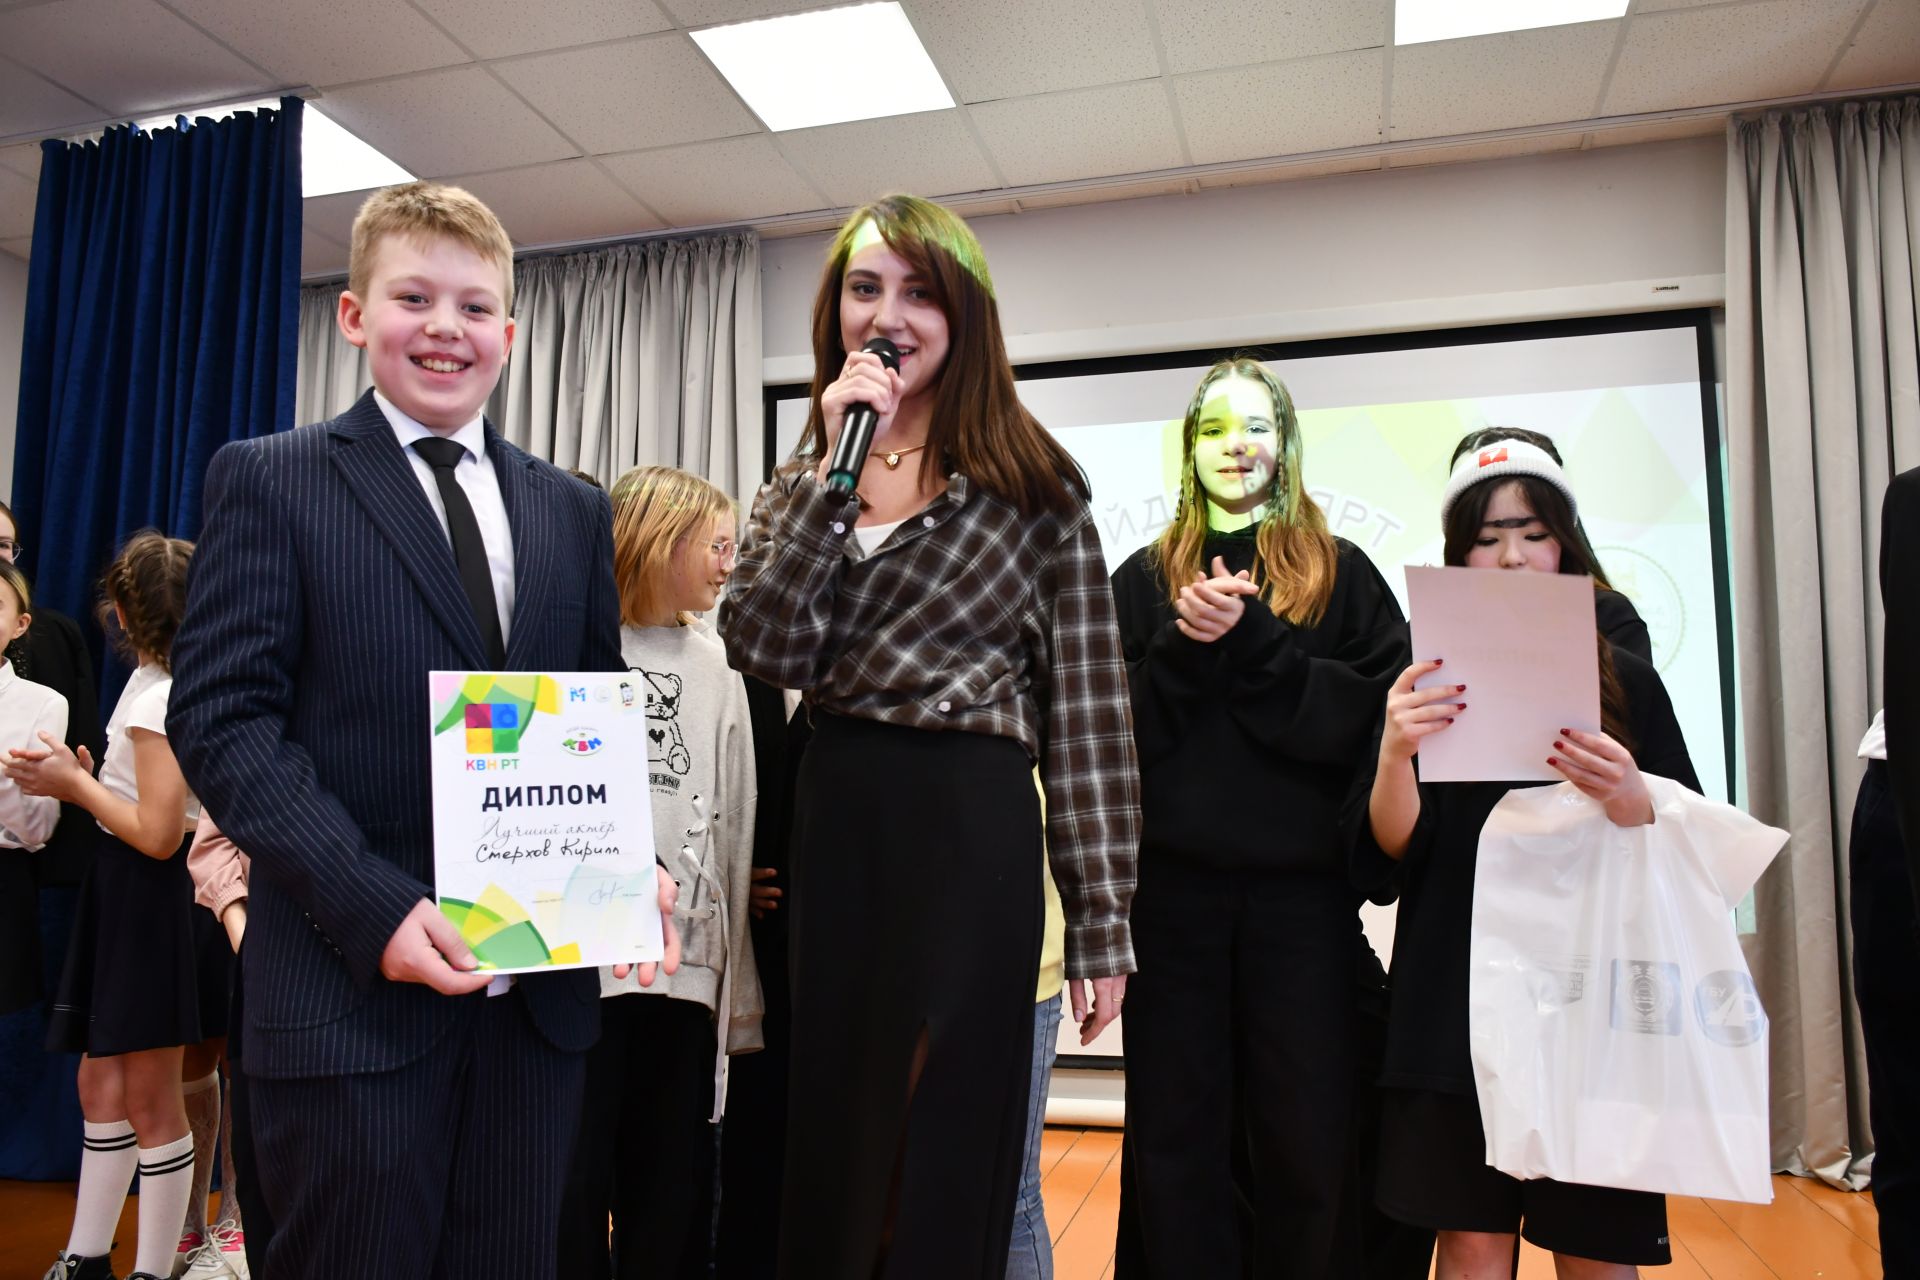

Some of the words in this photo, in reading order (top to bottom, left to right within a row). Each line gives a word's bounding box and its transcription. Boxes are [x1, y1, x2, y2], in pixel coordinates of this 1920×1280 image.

[466, 759, 497, 771] КВН
[501, 759, 520, 770] РТ
[482, 783, 607, 812] ДИПЛОМ
[473, 816, 560, 849] Лучший
[476, 838, 551, 864] Стерхов
[560, 838, 620, 862] Кирилл
